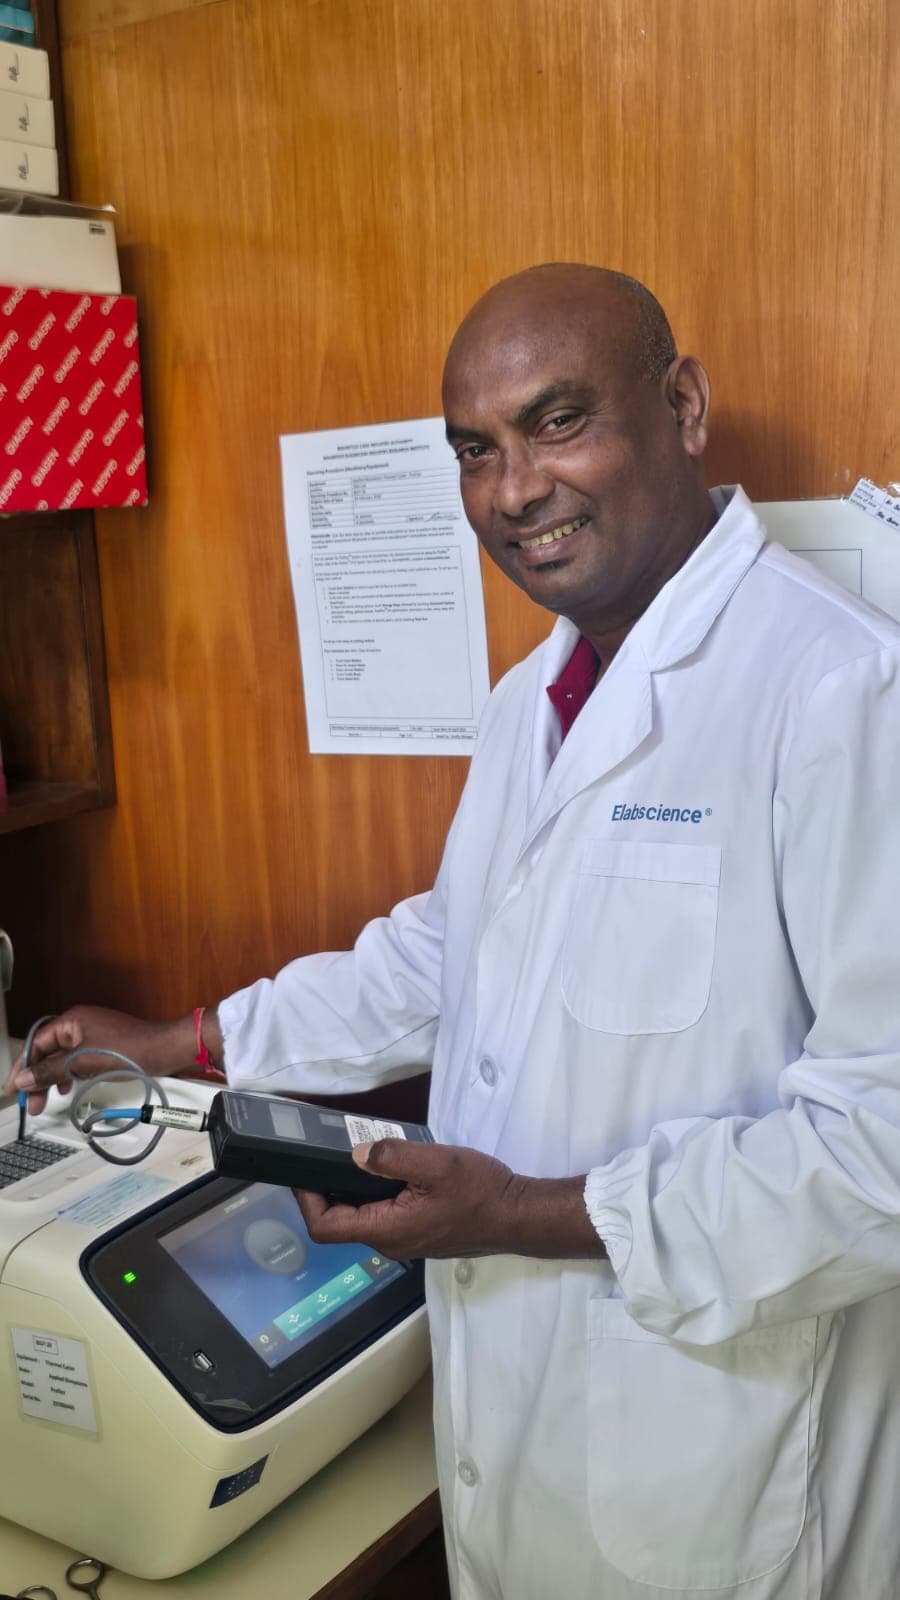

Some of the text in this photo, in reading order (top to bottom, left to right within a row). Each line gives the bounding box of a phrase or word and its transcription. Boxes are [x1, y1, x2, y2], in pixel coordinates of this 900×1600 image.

[28, 312, 57, 351] QIAGEN
[64, 295, 92, 333] QIAGEN
[53, 346, 81, 384] QIAGEN
[89, 328, 116, 366] QIAGEN
[16, 364, 45, 403] QIAGEN
[78, 378, 105, 416] QIAGEN
[113, 360, 139, 398] QIAGEN
[42, 396, 70, 436] QIAGEN
[102, 409, 129, 447] QIAGEN
[4, 416, 34, 456] QIAGEN
[67, 428, 94, 467] QIAGEN
[31, 448, 60, 487] QIAGEN
[91, 459, 118, 497] QIAGEN
